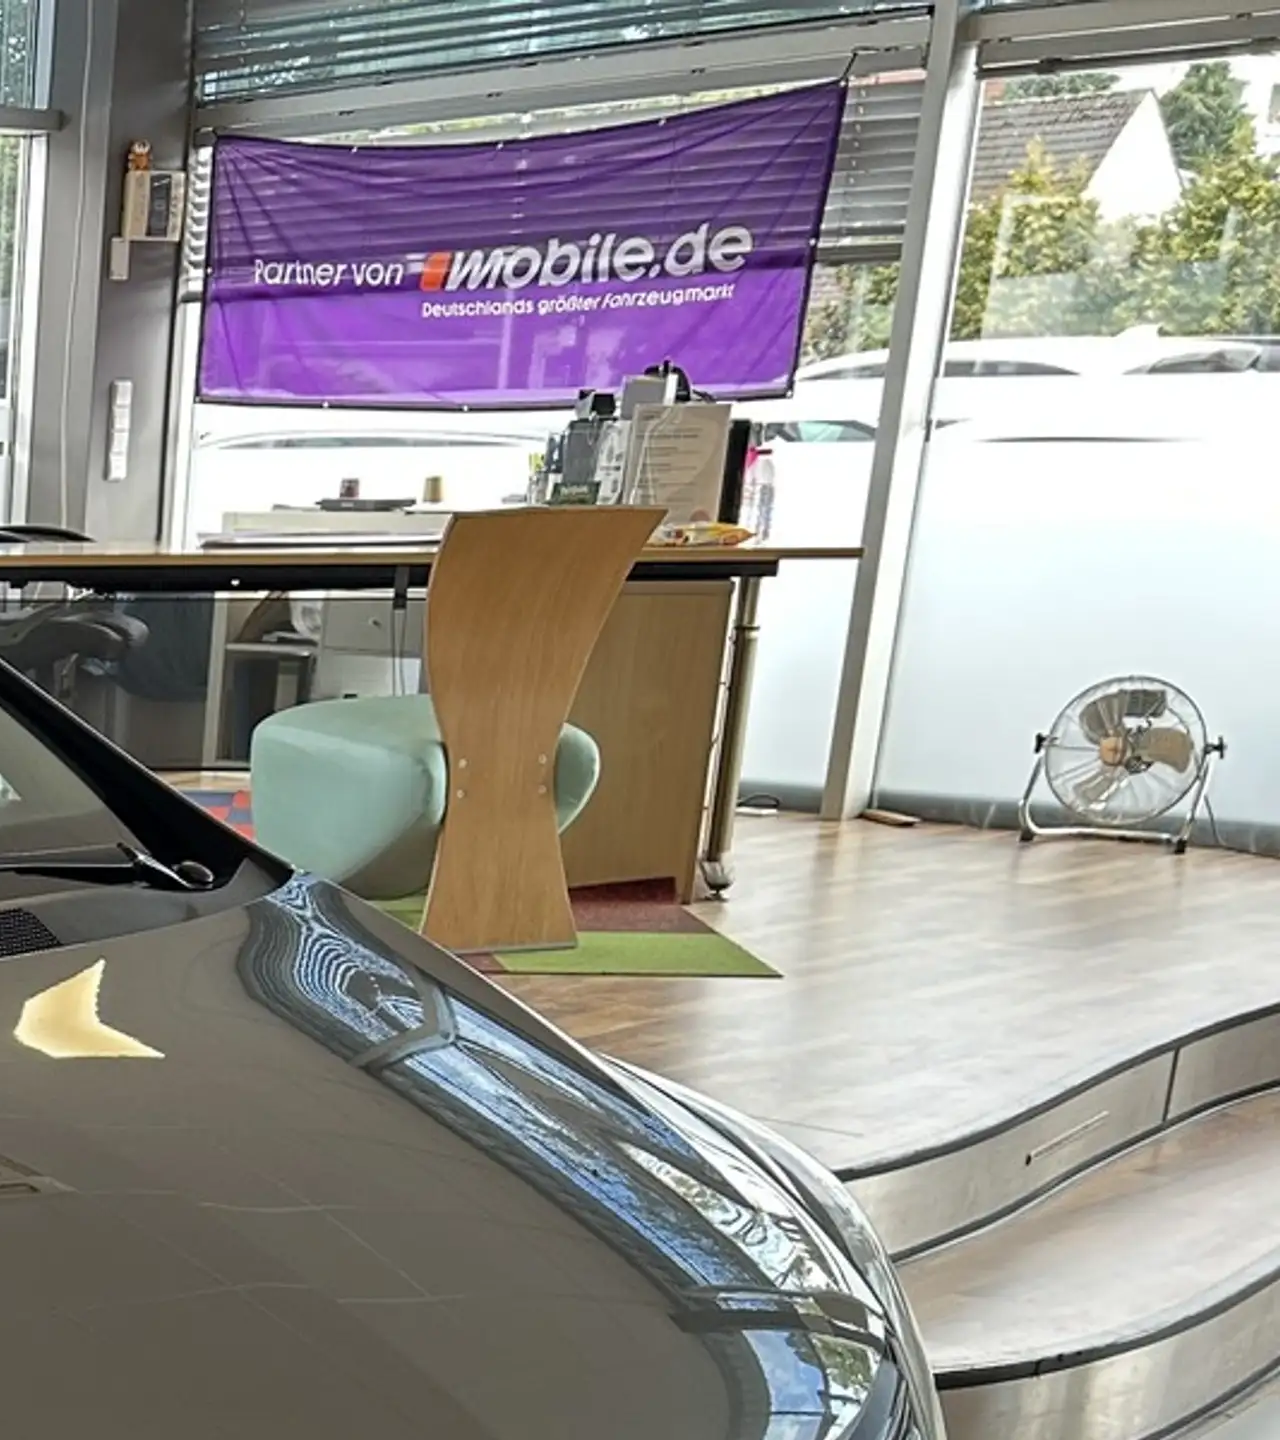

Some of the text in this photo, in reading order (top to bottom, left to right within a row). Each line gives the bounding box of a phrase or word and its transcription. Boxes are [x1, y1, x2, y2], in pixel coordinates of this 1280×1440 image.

[253, 222, 754, 292] Partner von mobile.de
[422, 298, 535, 318] Deutschlands
